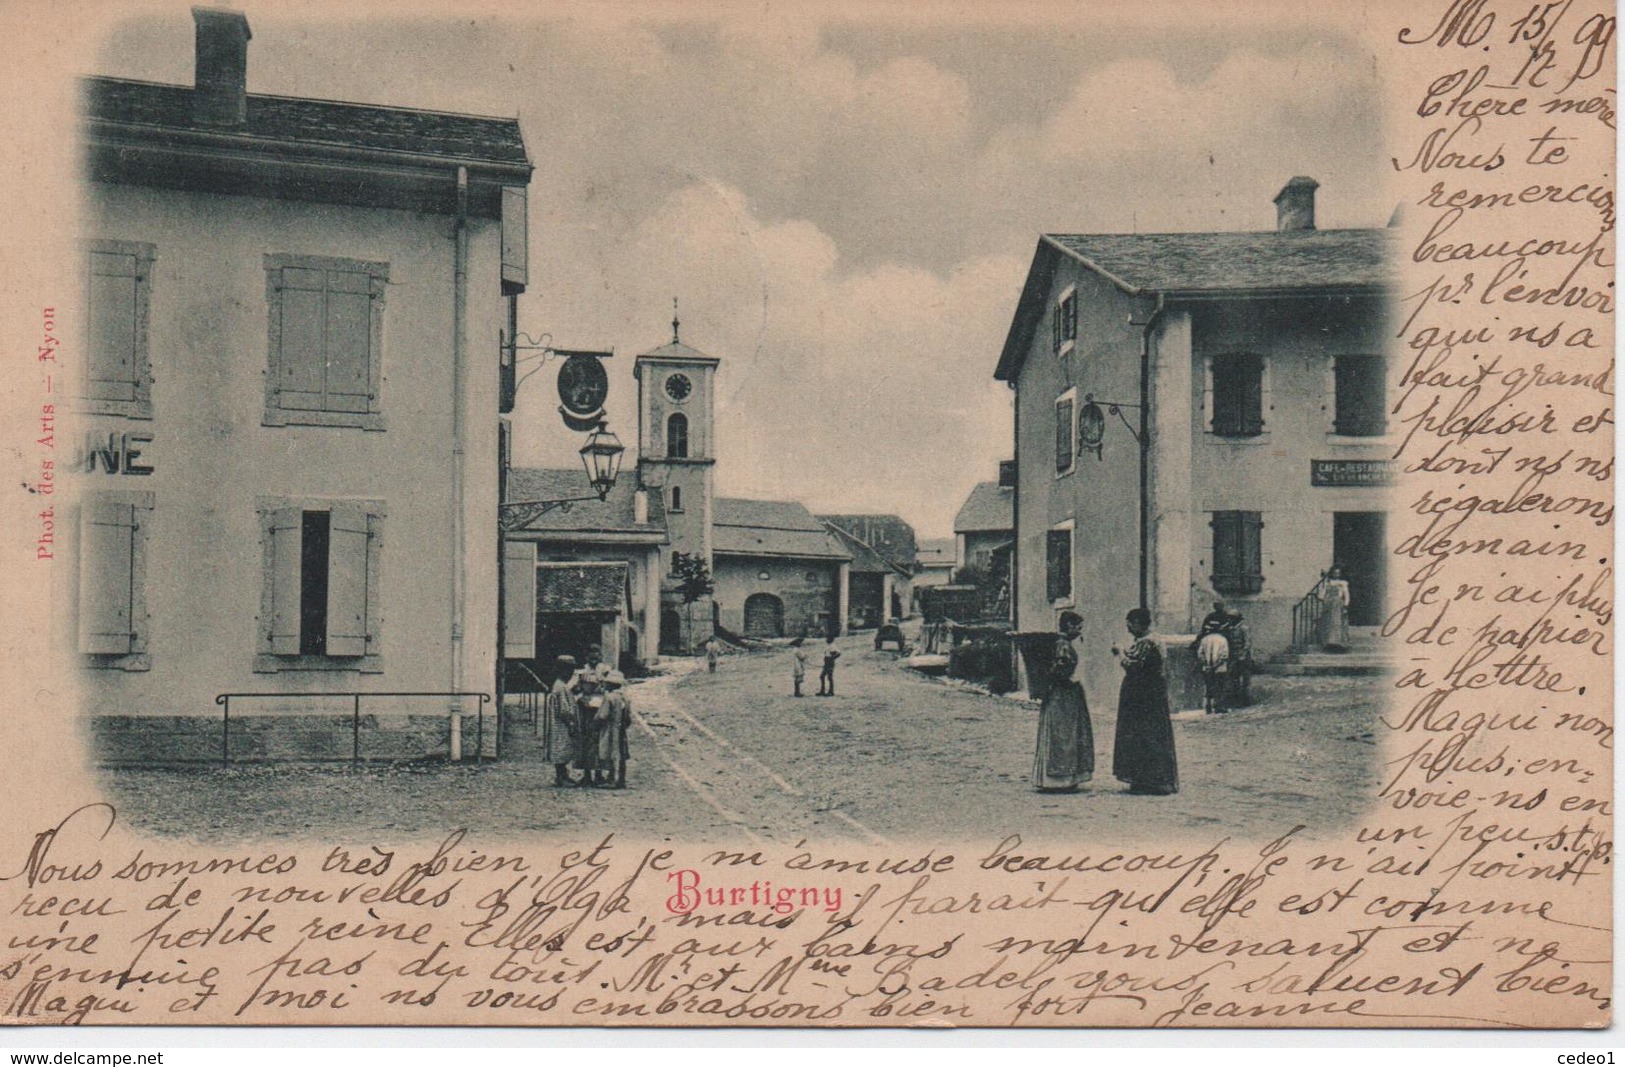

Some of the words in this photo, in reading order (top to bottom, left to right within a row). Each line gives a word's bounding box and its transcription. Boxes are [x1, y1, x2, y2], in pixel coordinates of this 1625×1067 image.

[1392, 116, 1506, 174] Nous
[1526, 126, 1579, 165] te
[1412, 207, 1617, 290] beaucoup
[38, 307, 60, 362] Nyon
[1400, 315, 1496, 388] qui
[1560, 327, 1600, 349] a
[1393, 347, 1503, 414] fait
[37, 403, 56, 449] Arts
[1393, 385, 1558, 460] plaisir
[1572, 408, 1616, 435] et
[37, 460, 55, 496] des
[1405, 439, 1513, 475] dont
[37, 506, 56, 561] Phot.
[1381, 556, 1440, 638] Je
[1520, 567, 1614, 640] plus
[1405, 598, 1455, 645] de
[1452, 615, 1610, 672] papier
[1553, 712, 1615, 750] non
[1559, 793, 1614, 817] en
[0, 803, 117, 889] Nous
[111, 848, 298, 883] sommes
[320, 846, 395, 877] très
[560, 831, 616, 871] et
[1240, 824, 1305, 884] Je
[1430, 843, 1601, 900] point
[1356, 824, 1431, 845] un
[1417, 809, 1536, 868] peu
[145, 877, 202, 911] de
[230, 864, 463, 908] nouvelles
[661, 905, 806, 930] mais
[826, 882, 882, 928] il
[1277, 878, 1358, 918] est
[1363, 892, 1570, 926] comme
[665, 868, 843, 914] Burtigny
[672, 936, 777, 957] aux
[799, 920, 966, 962] bains
[1402, 920, 1485, 954] et
[243, 938, 377, 1005] pas
[395, 942, 470, 978] du
[693, 966, 746, 993] et
[1063, 962, 1225, 996] vous
[1231, 949, 1484, 997] saluent
[168, 984, 219, 1012] et
[258, 984, 351, 1010] moi
[464, 985, 563, 1012] vous
[572, 983, 861, 1019] embrassons
[867, 991, 975, 1019] bien
[1003, 980, 1147, 1027] fort
[1152, 983, 1372, 1027] Jeanne
